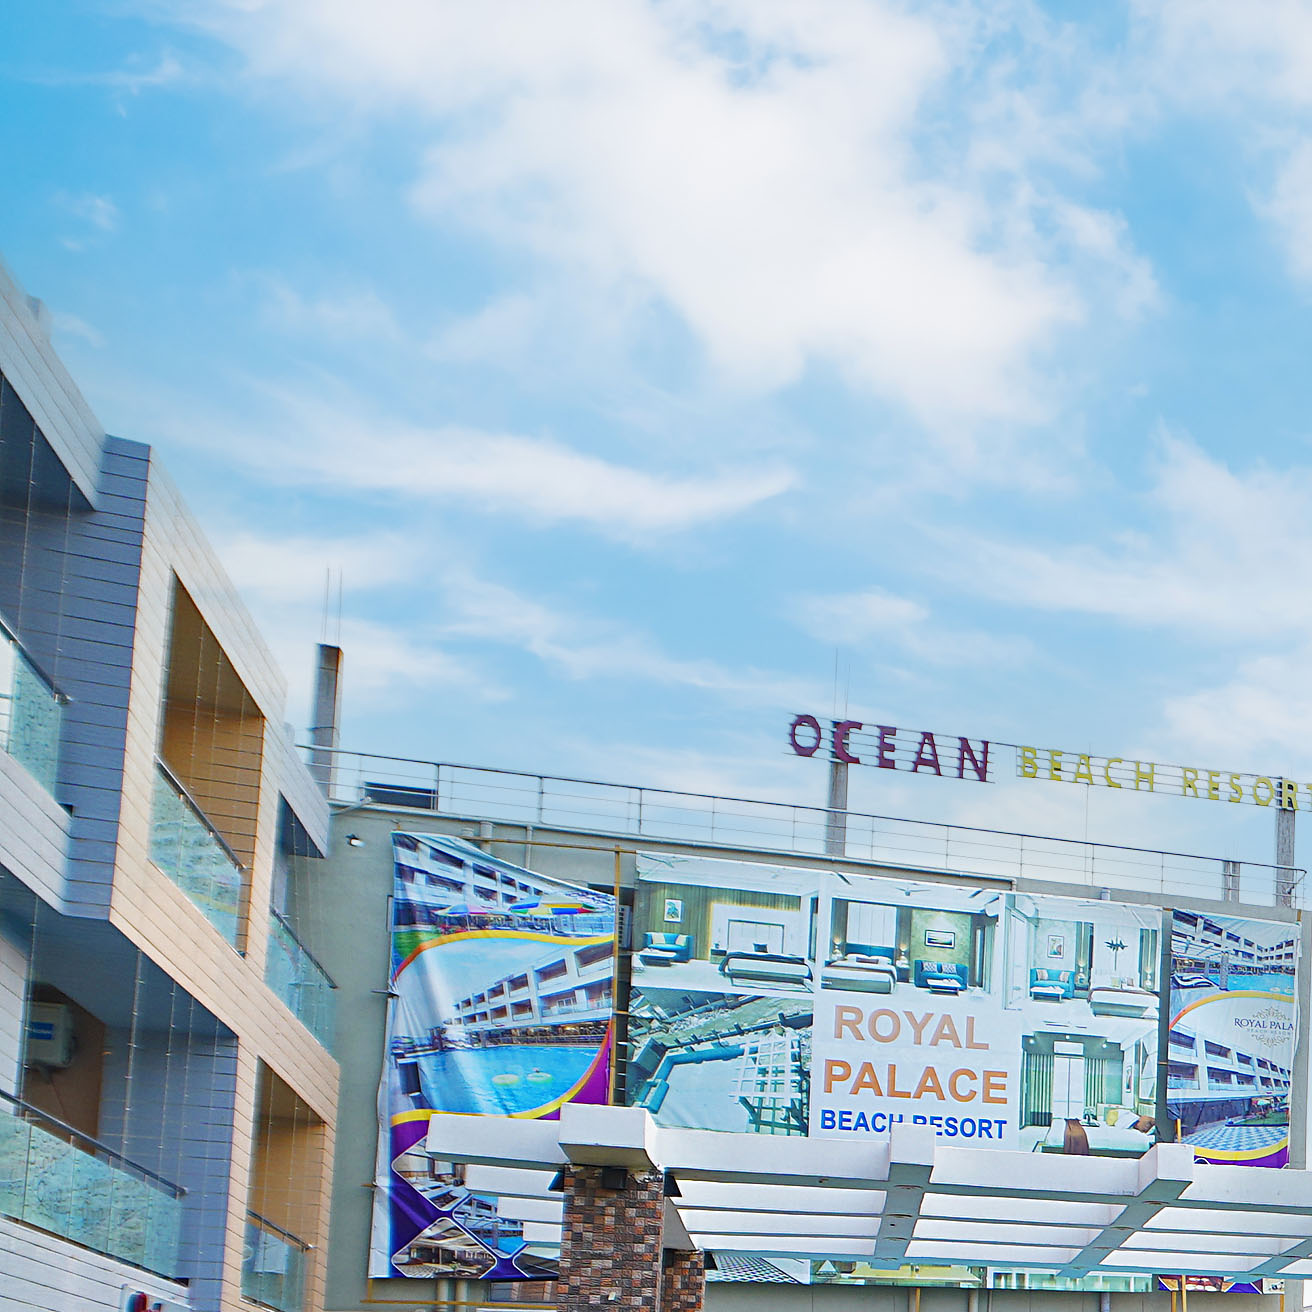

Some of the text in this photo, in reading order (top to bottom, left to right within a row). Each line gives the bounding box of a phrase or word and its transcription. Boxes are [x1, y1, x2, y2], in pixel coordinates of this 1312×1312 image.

[789, 714, 989, 782] OCEAN
[1021, 746, 1155, 792] BEACH
[834, 1005, 989, 1050] ROYAL
[1234, 1018, 1267, 1028] ROYAL
[823, 1059, 1008, 1105] PALACE
